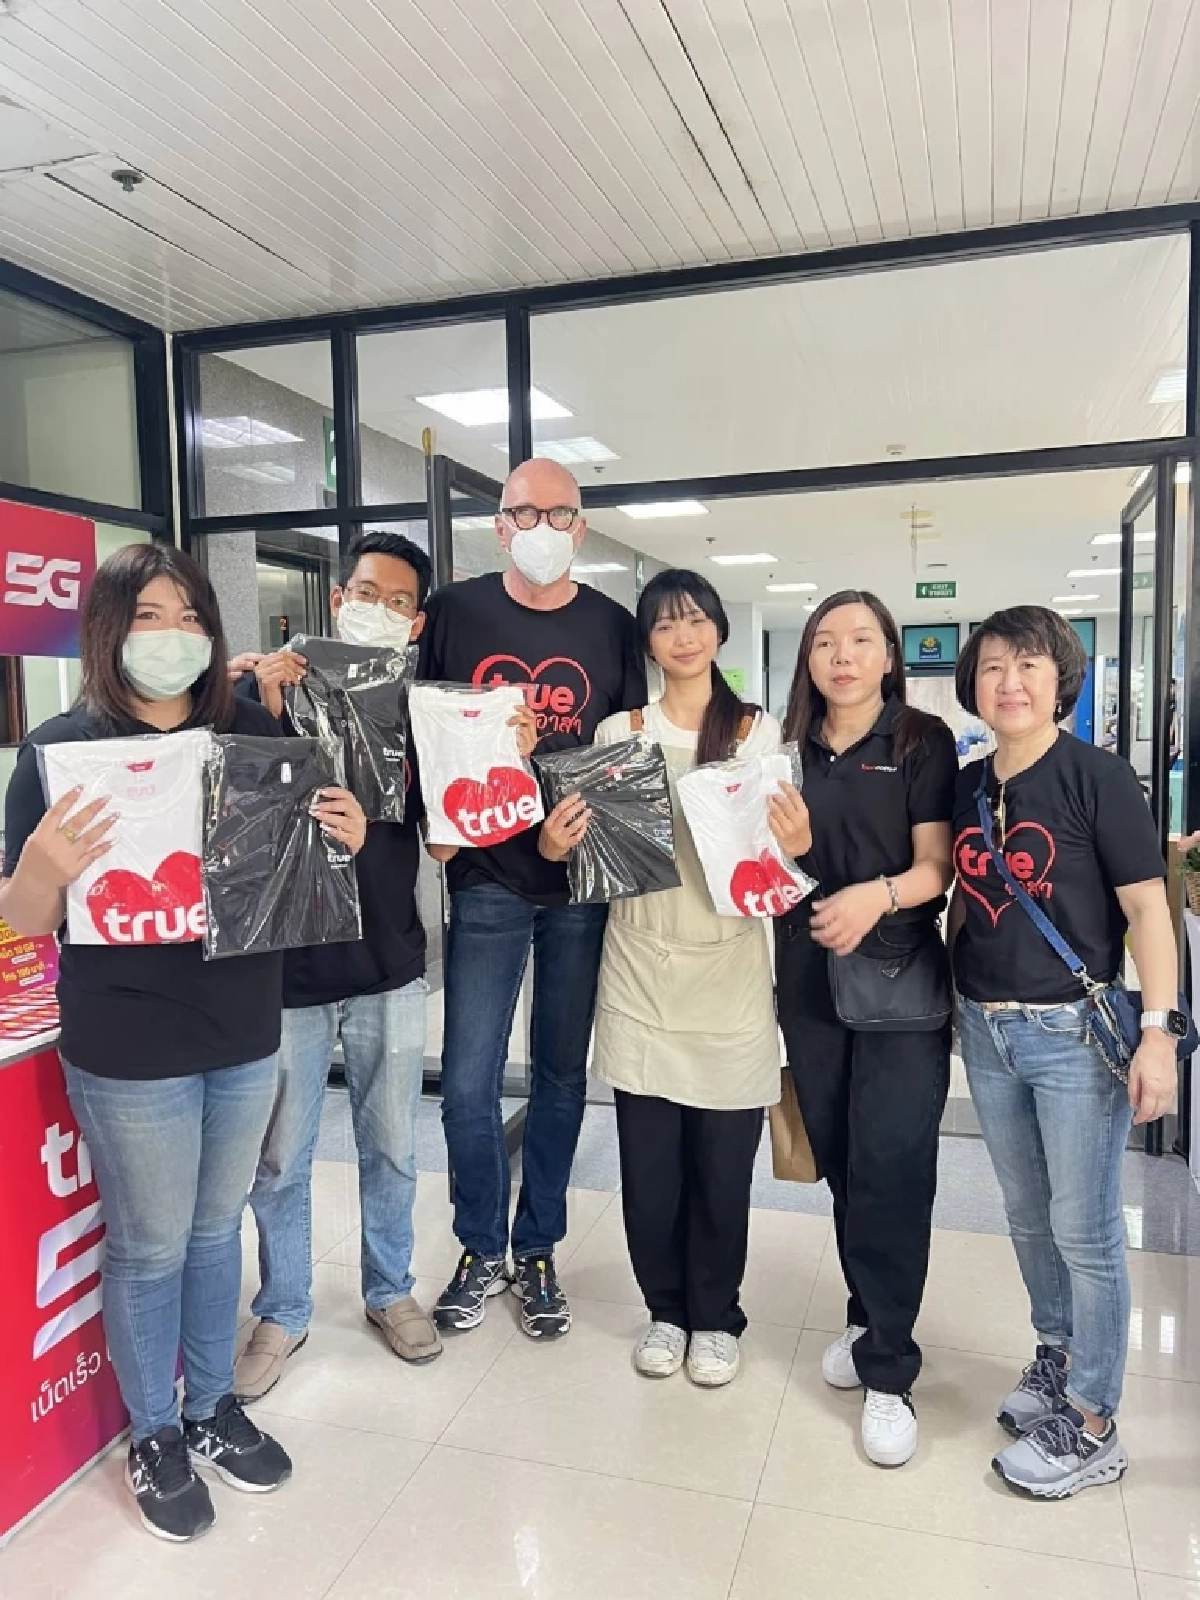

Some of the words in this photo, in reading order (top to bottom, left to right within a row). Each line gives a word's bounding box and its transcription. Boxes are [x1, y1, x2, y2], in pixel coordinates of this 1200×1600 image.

[4, 551, 81, 610] 5G
[458, 795, 535, 837] true
[960, 844, 1035, 879] tre
[103, 902, 206, 941] true
